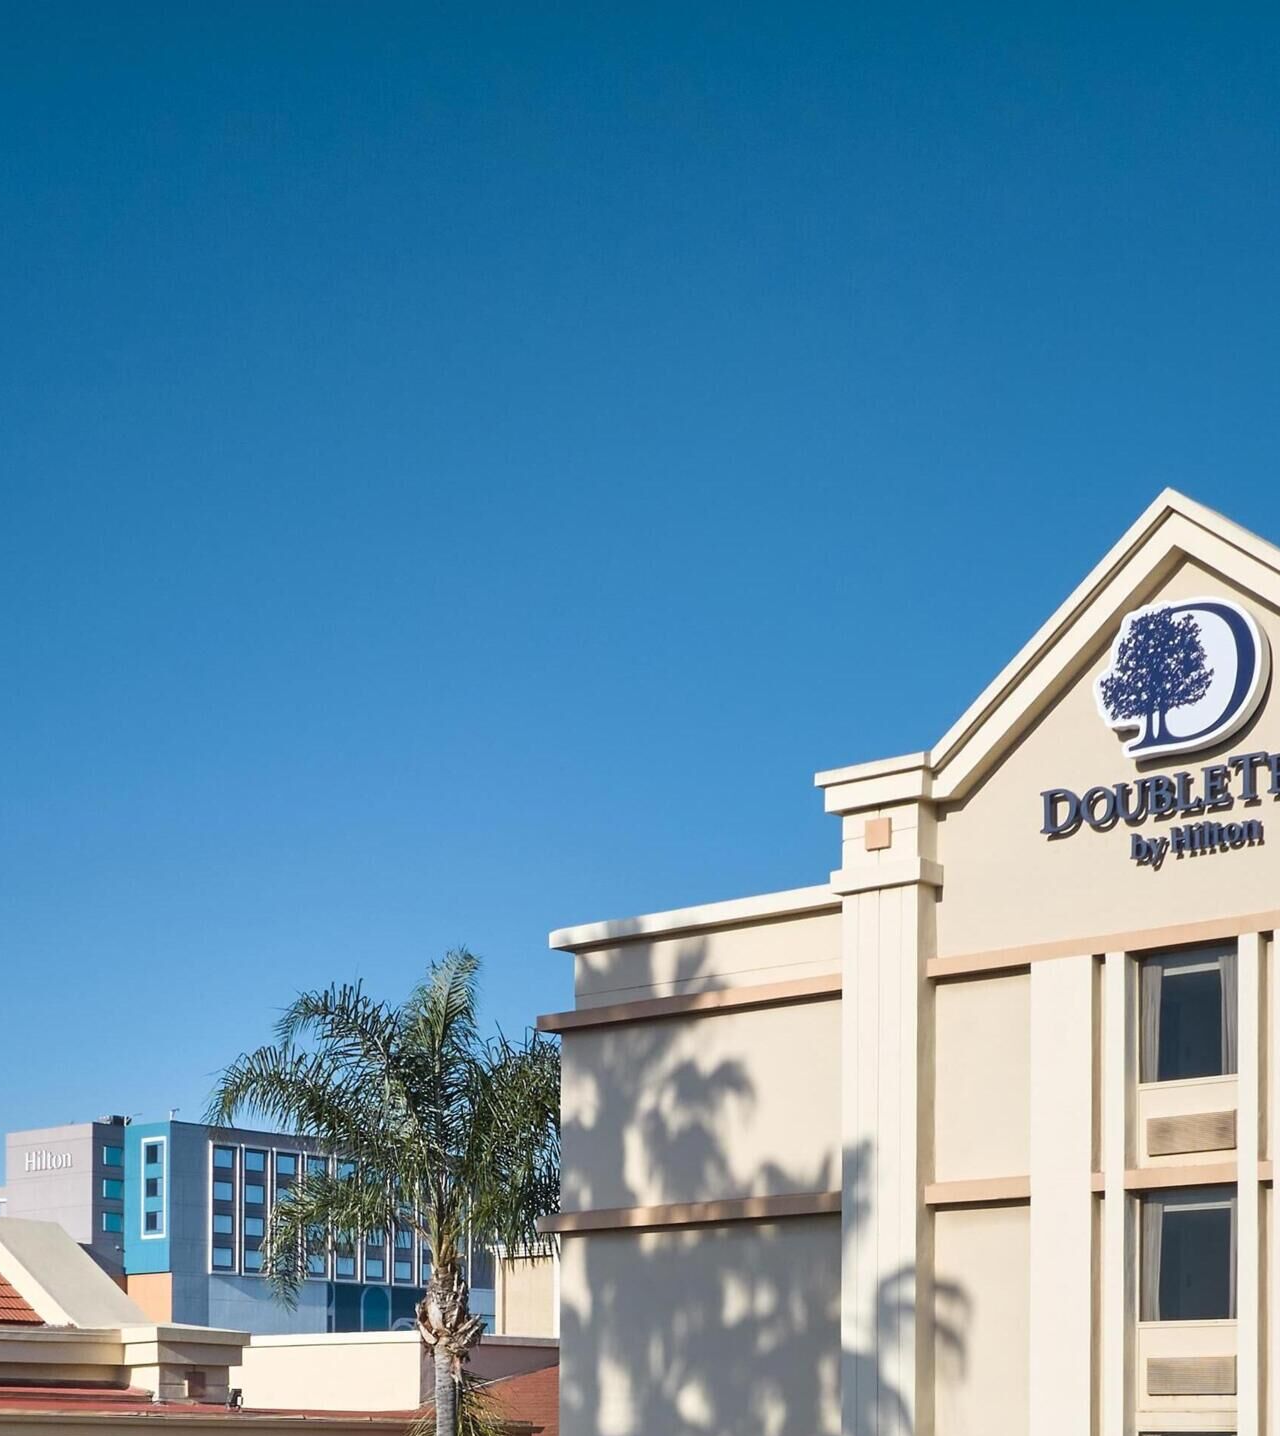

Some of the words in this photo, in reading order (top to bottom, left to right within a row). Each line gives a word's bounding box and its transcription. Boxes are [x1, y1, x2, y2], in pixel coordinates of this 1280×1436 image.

[1130, 832, 1167, 866] by
[1170, 818, 1263, 852] Hilton
[24, 1150, 72, 1172] Hilton
